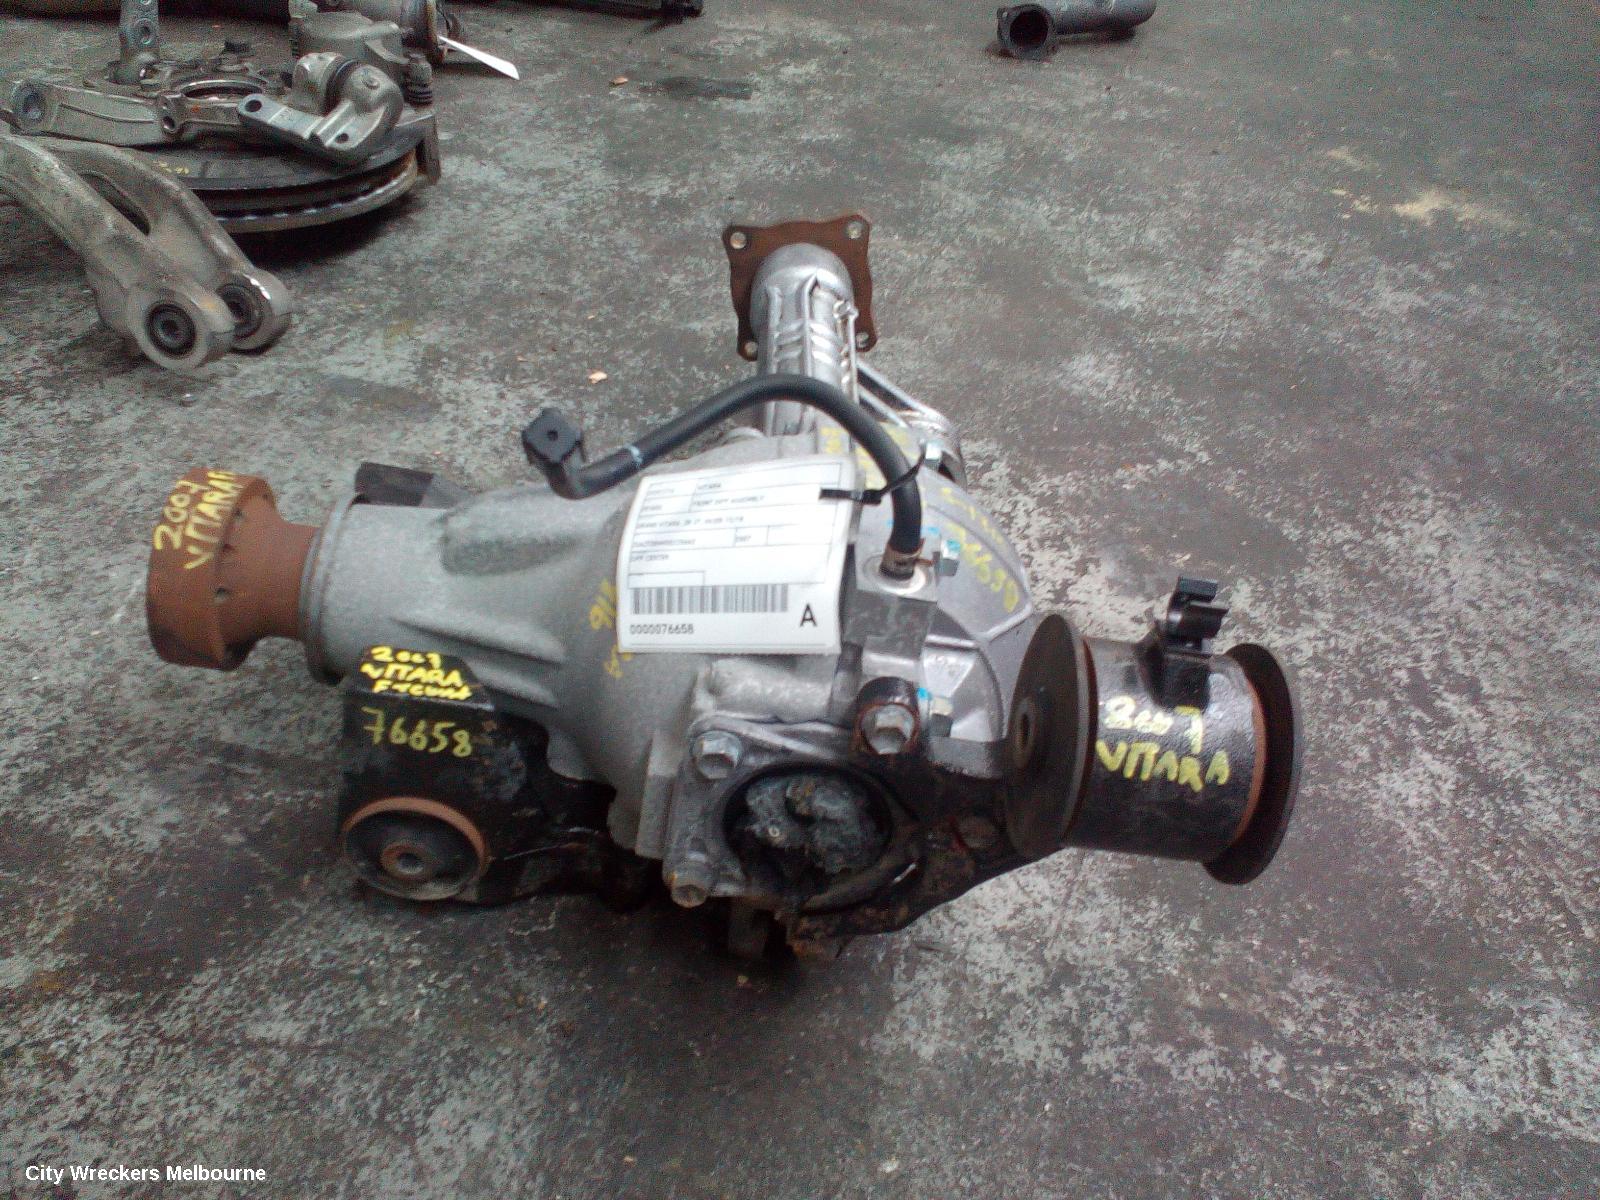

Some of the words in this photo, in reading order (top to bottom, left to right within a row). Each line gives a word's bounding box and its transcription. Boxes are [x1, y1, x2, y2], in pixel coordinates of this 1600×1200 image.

[629, 623, 694, 635] 0000076658
[799, 604, 817, 628] A
[361, 705, 472, 758] 76658
[1095, 740, 1232, 793] VITARA
